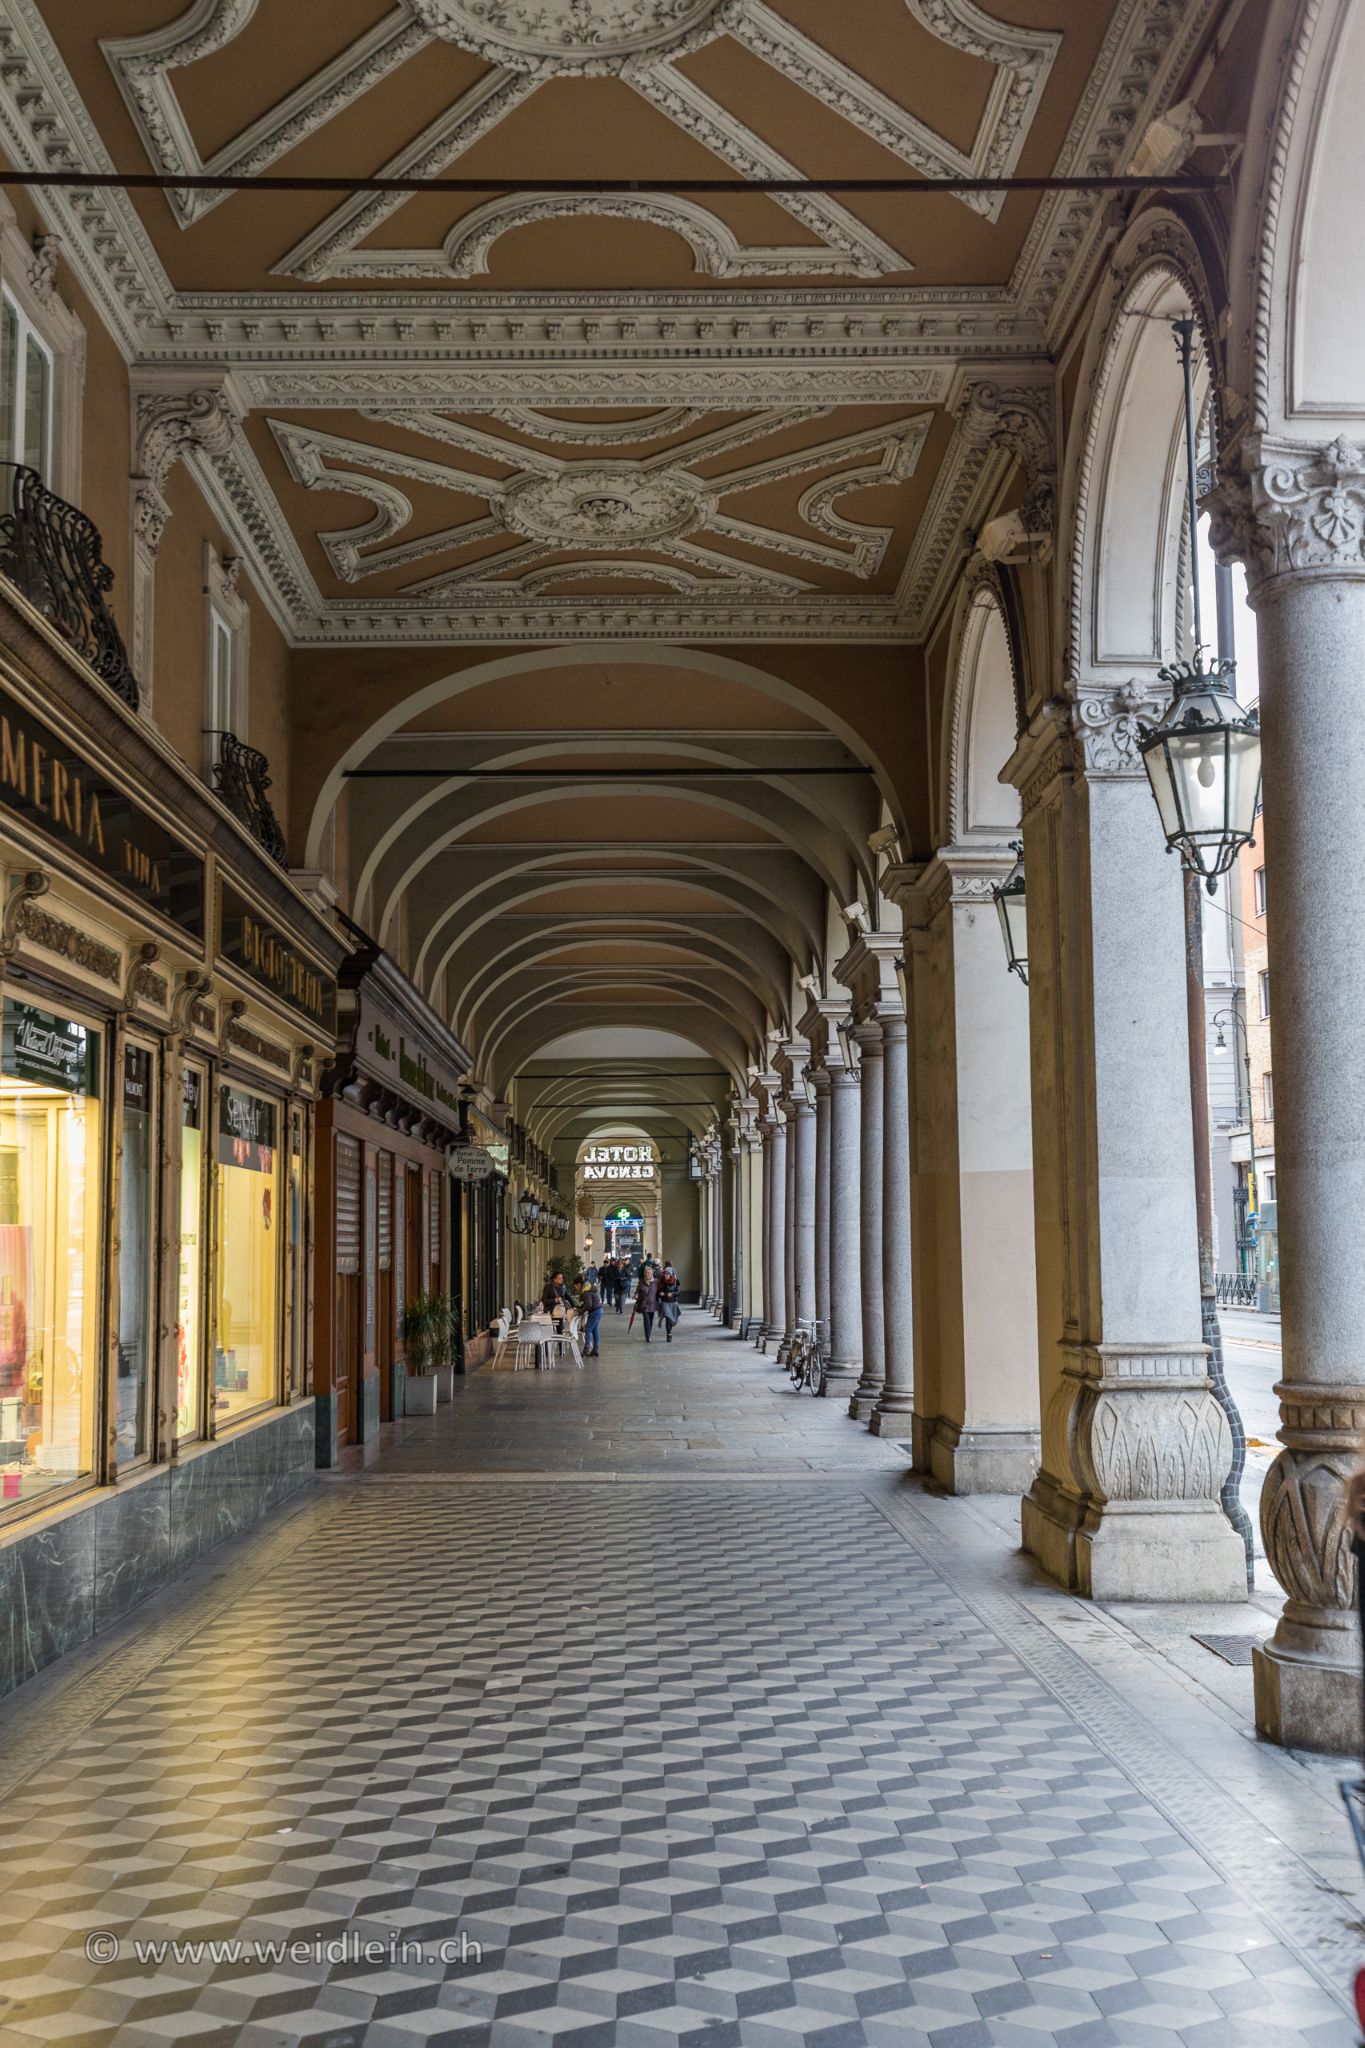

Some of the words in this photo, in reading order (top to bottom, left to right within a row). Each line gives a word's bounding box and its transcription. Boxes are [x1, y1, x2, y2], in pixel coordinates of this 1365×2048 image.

[457, 1156, 485, 1165] Pomme
[454, 1164, 464, 1172] de
[466, 1164, 487, 1173] Terre
